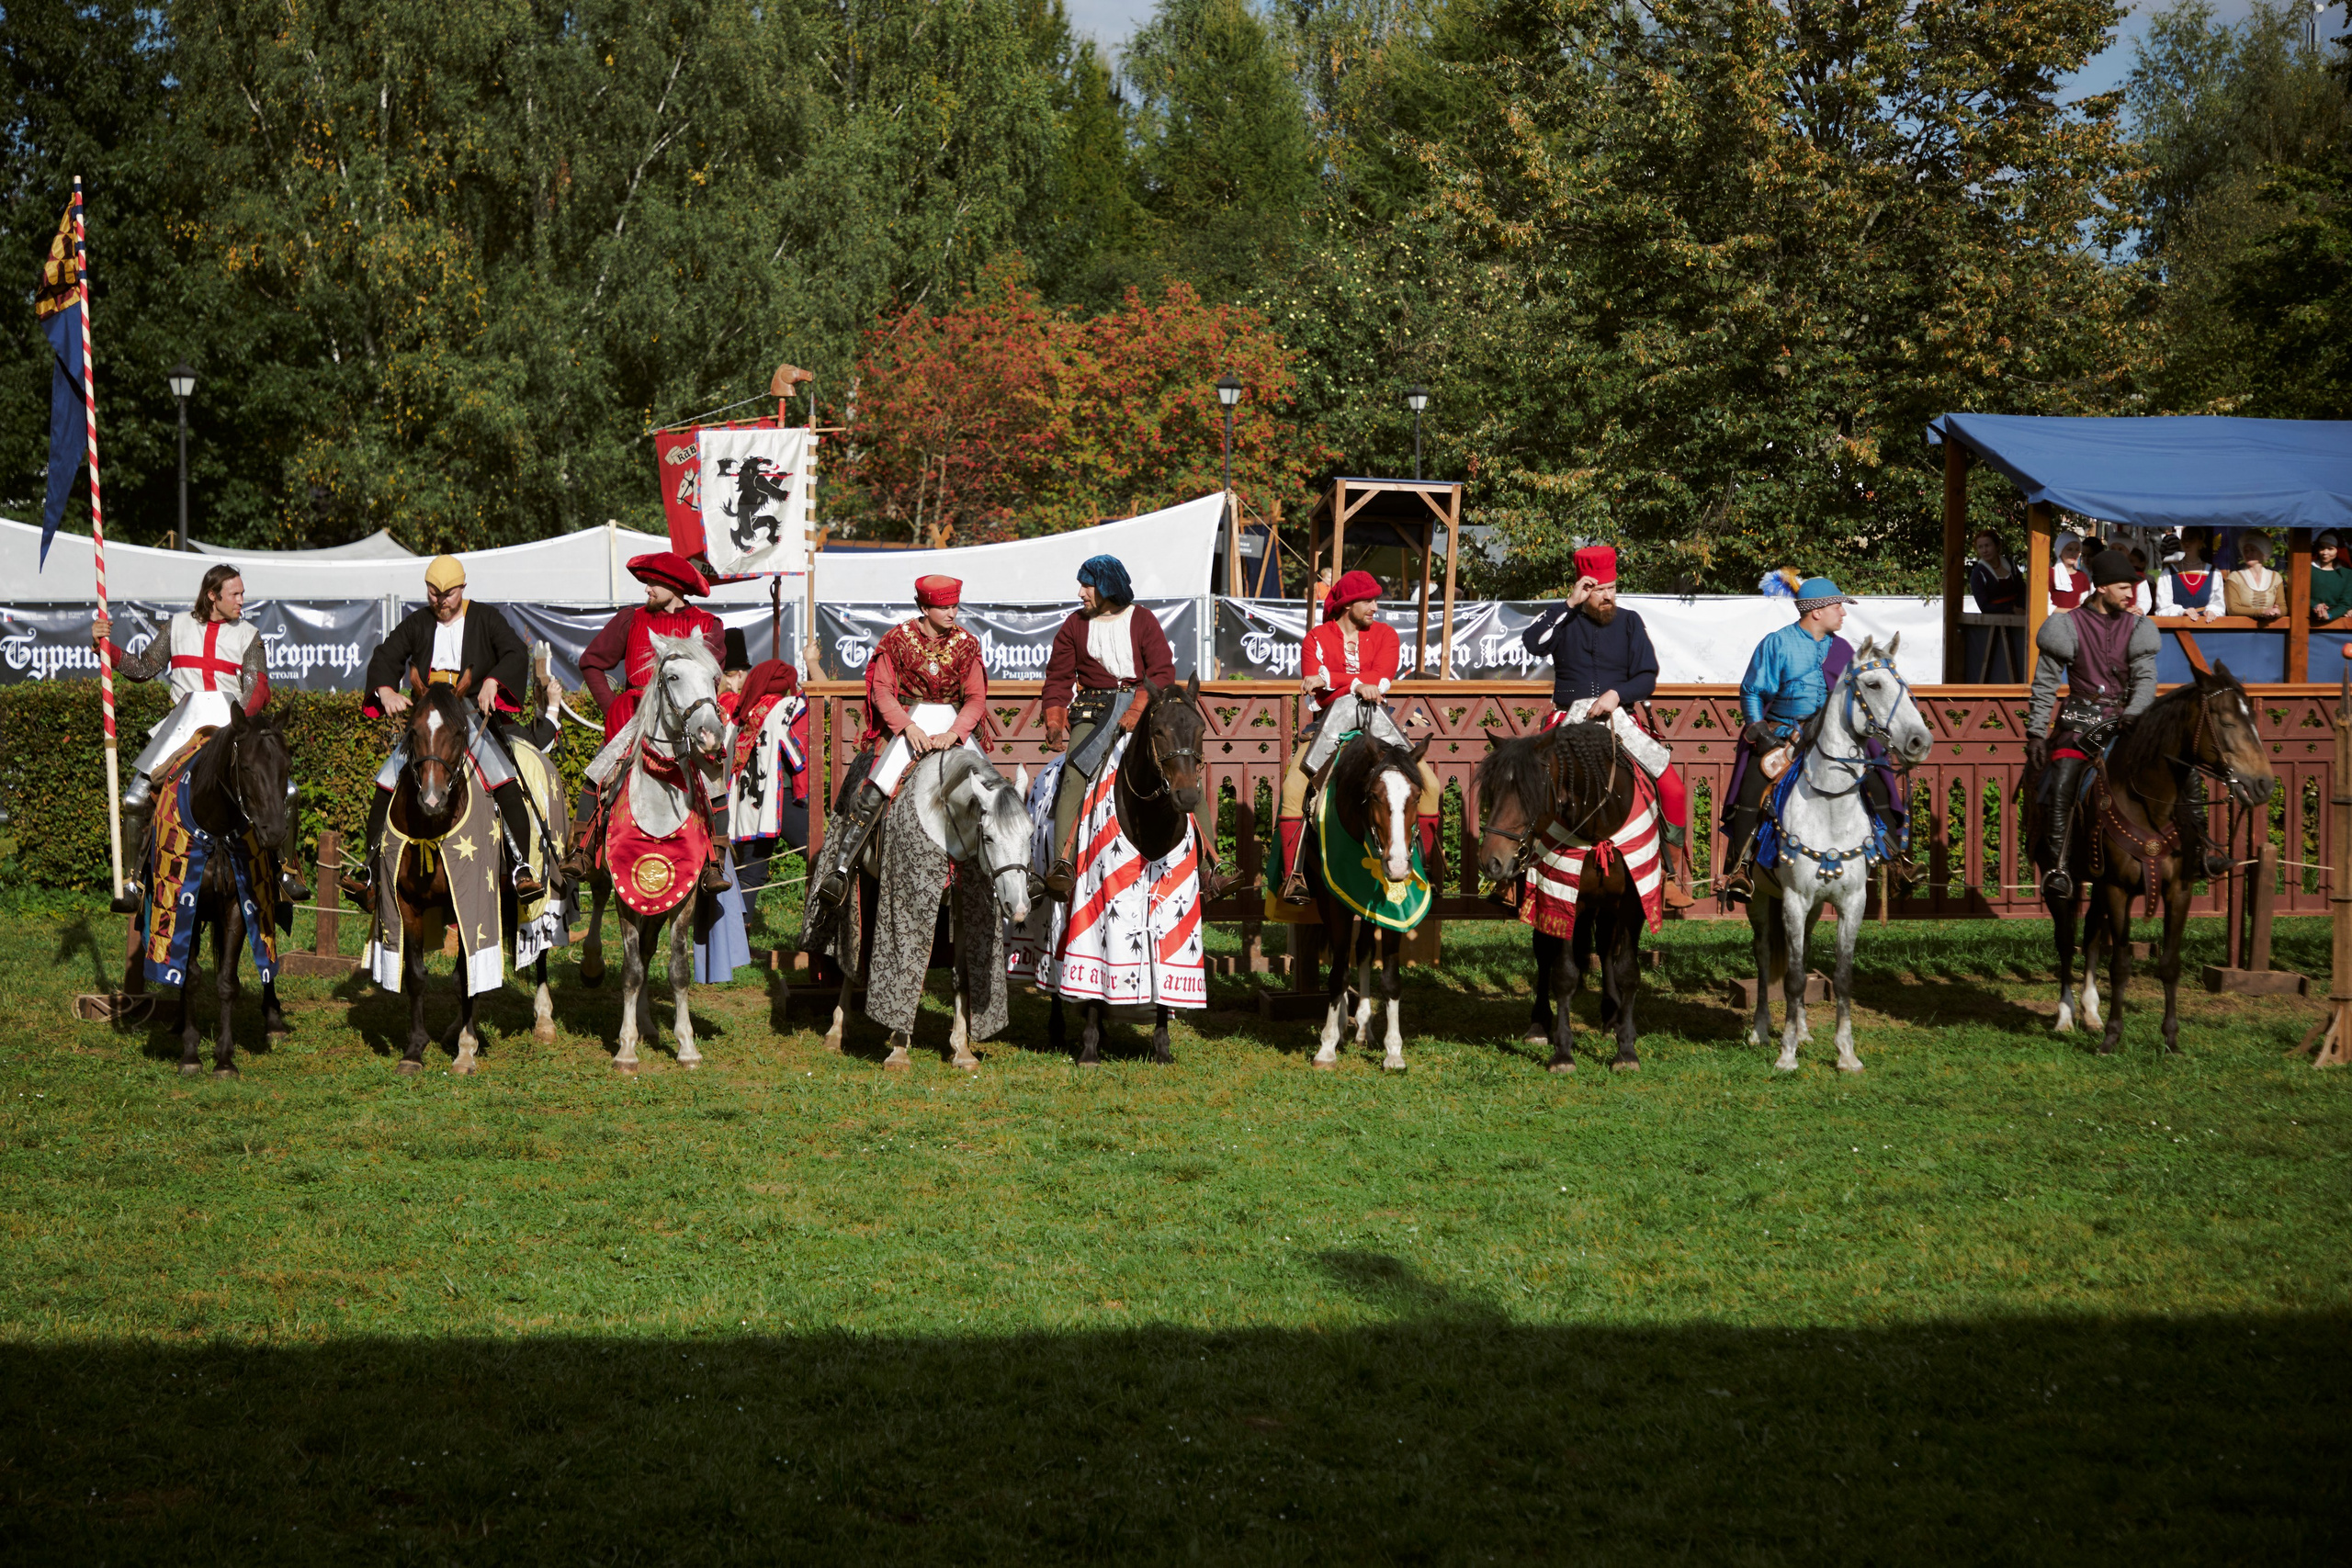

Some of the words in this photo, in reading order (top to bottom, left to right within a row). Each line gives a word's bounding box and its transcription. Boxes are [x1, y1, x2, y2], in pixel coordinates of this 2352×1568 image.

[0, 627, 102, 680] Турни
[1240, 626, 1302, 677] Тур
[269, 671, 300, 680] стола
[1002, 670, 1043, 681] Рыцари
[1069, 964, 1085, 982] et
